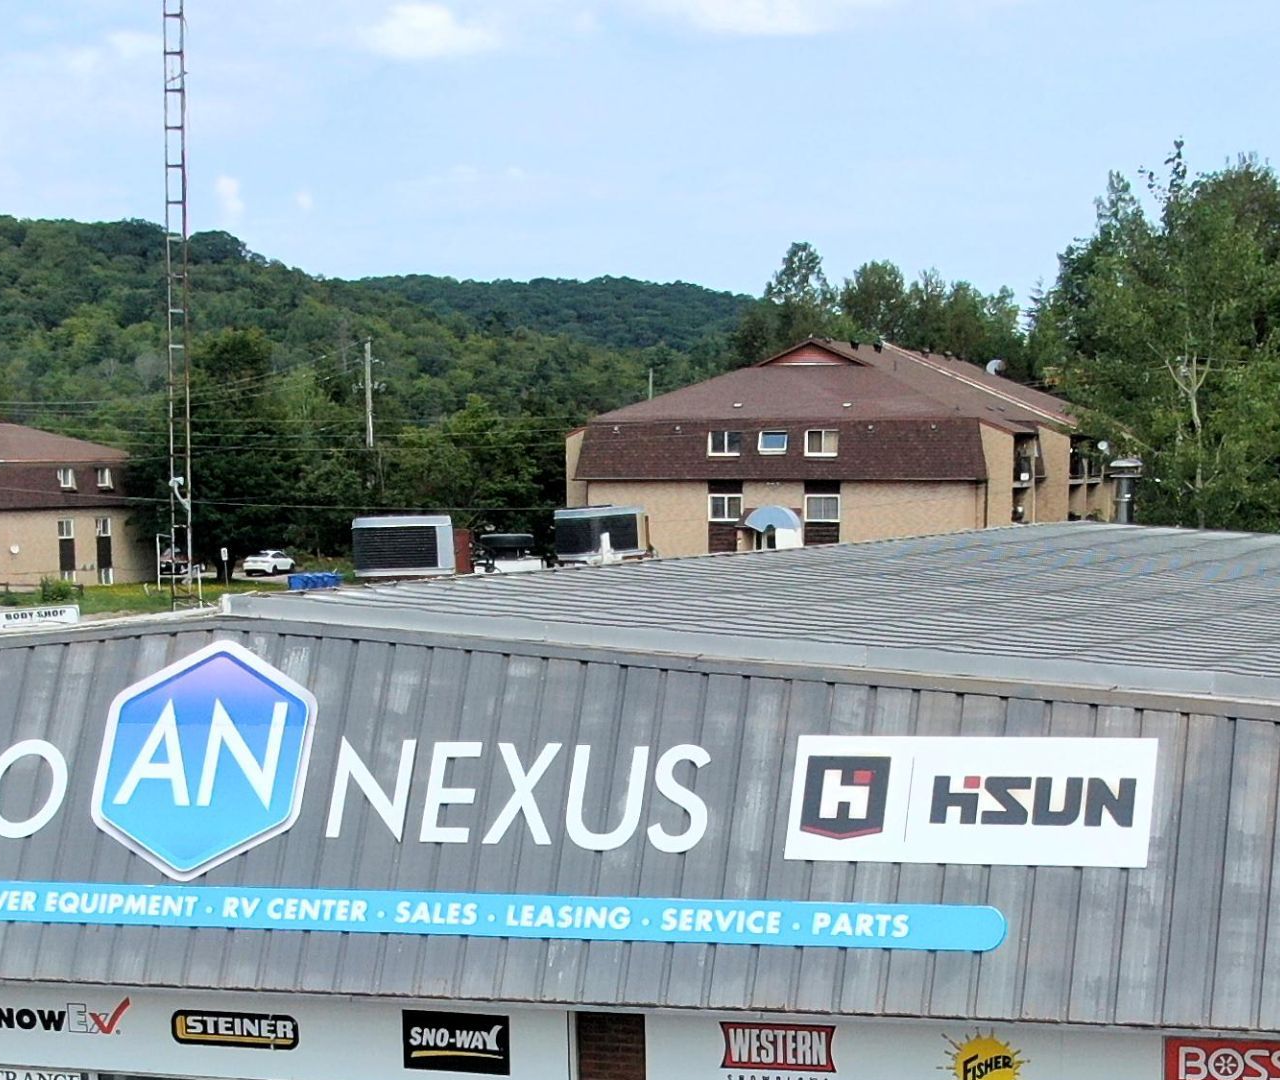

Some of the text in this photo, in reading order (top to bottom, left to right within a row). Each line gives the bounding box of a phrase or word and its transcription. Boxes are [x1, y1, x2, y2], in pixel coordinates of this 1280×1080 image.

[5, 612, 34, 620] BODY
[112, 697, 289, 811] AN
[325, 737, 711, 853] NEXUS
[44, 891, 198, 918] EQUIPMENT
[222, 896, 261, 918] RV
[266, 897, 369, 922] CENTER
[394, 901, 479, 926] SALES
[505, 904, 631, 930] LEASING
[660, 908, 783, 934] SERVICE
[811, 911, 910, 938] PARTS
[186, 1015, 294, 1039] STEINER
[409, 1024, 503, 1051] SNO-WAY
[728, 1028, 827, 1065] WESTERN
